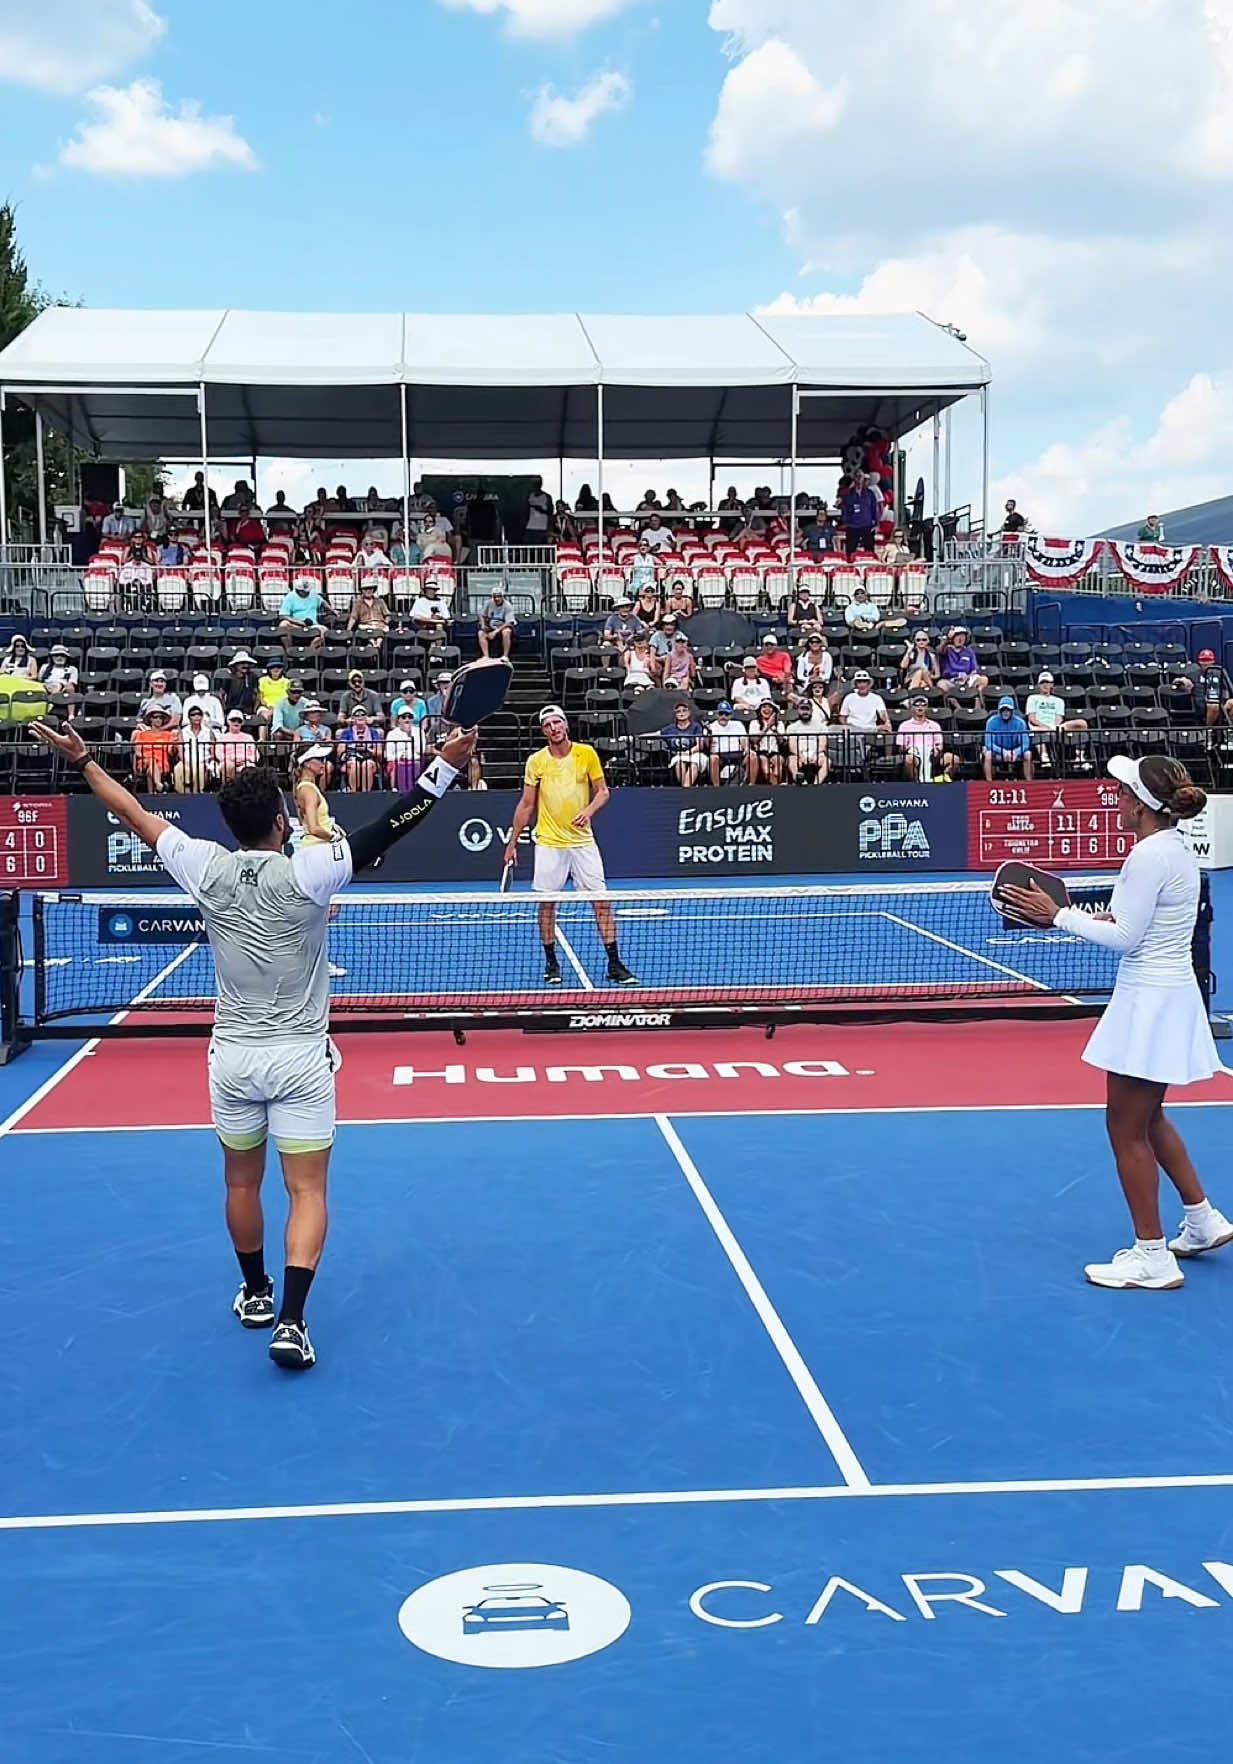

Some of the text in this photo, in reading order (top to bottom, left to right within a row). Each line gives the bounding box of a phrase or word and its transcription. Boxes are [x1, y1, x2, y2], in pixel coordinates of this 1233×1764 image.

[878, 799, 929, 808] CARVANA
[989, 789, 1028, 805] 31:11
[17, 810, 39, 823] 96F
[400, 798, 433, 824] JOOLA
[678, 798, 774, 834] Ensure
[1056, 815, 1076, 831] 11
[1088, 814, 1098, 830] 4
[4, 830, 45, 849] 4 0
[725, 825, 773, 843] MAX
[859, 813, 930, 851] PPA
[678, 845, 773, 863] PROTEIN
[1061, 838, 1071, 854] 6
[1090, 837, 1098, 854] 6
[1116, 836, 1126, 854] 0
[6, 855, 46, 873] 6 0
[138, 919, 206, 932] CARVAN
[569, 1013, 672, 1027] DOMINATOR
[392, 1060, 876, 1086] Humana.
[688, 1560, 1233, 1629] CARVA
